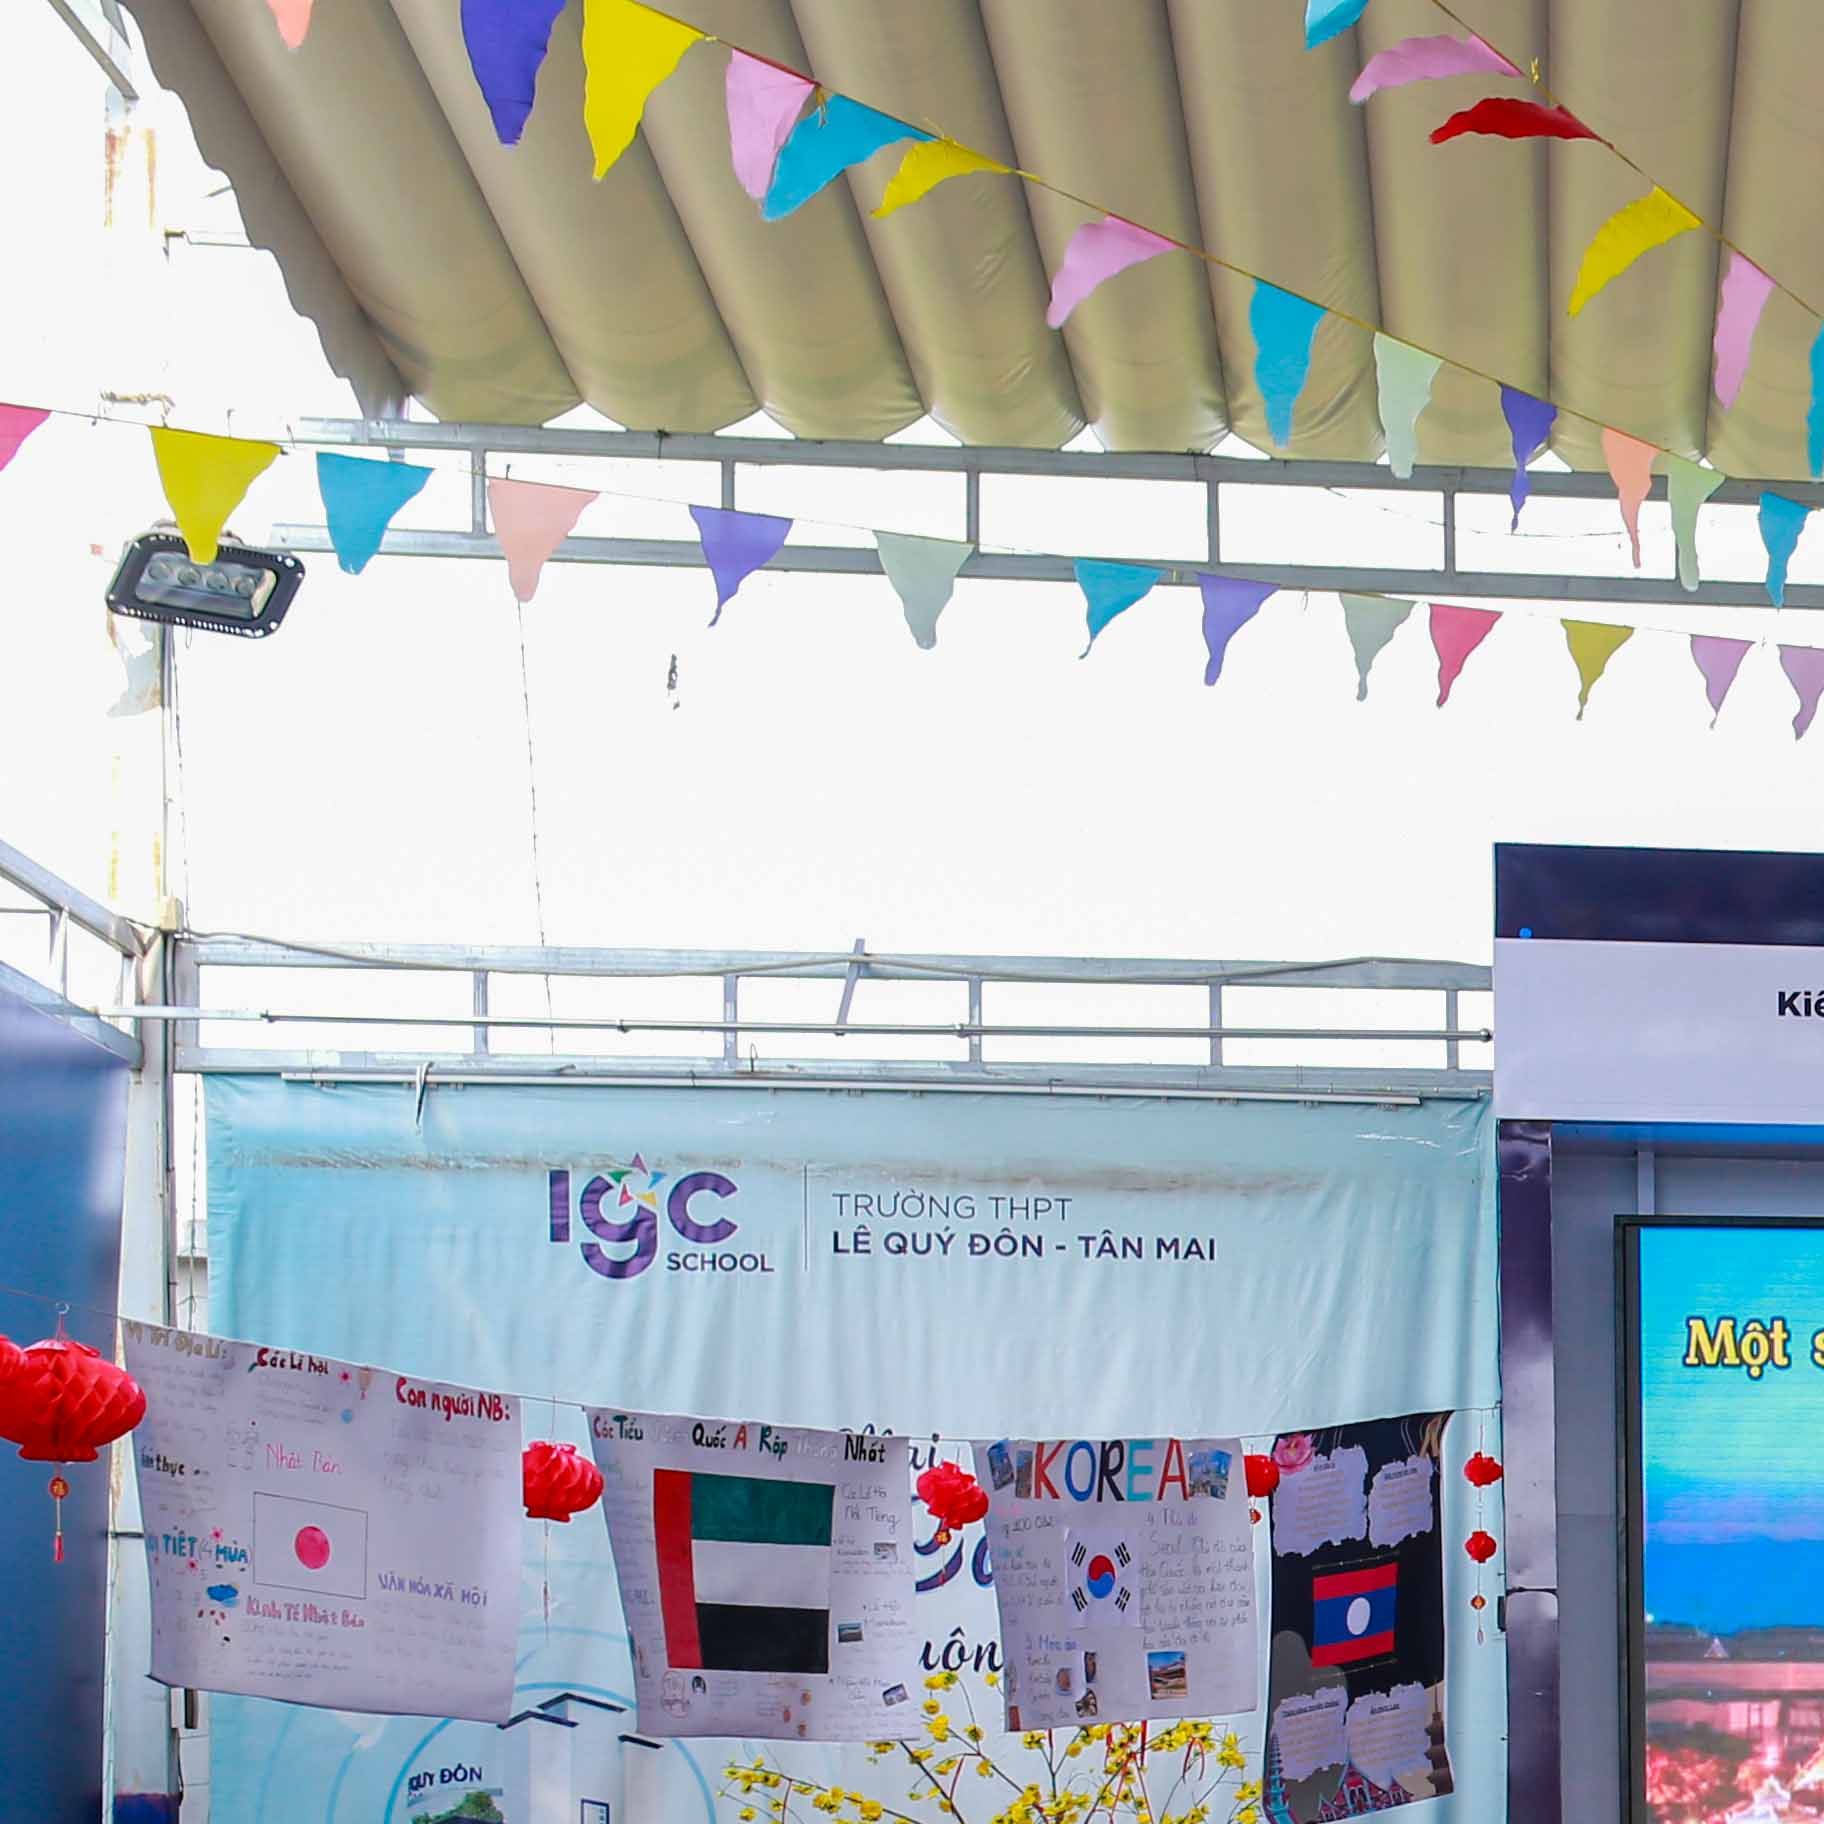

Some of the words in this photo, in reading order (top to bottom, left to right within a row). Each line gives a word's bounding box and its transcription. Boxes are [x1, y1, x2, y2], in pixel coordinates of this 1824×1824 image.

[832, 1186, 977, 1221] TRƯỜNG
[988, 1196, 1073, 1223] THPT
[666, 1251, 775, 1273] SCHOOL
[832, 1224, 872, 1256] LÊ
[882, 1225, 956, 1259] QUÝ
[967, 1228, 1045, 1259] ĐÔN
[1077, 1231, 1145, 1261] TÂN
[1156, 1236, 1218, 1263] MAI
[1683, 1316, 1790, 1377] Một
[396, 1376, 428, 1409] Con
[431, 1389, 476, 1423] người
[692, 1423, 728, 1450] Quốc
[844, 1434, 886, 1463] Nhất
[1034, 1438, 1190, 1502] KOREA
[440, 1763, 483, 1785] ĐÔN
